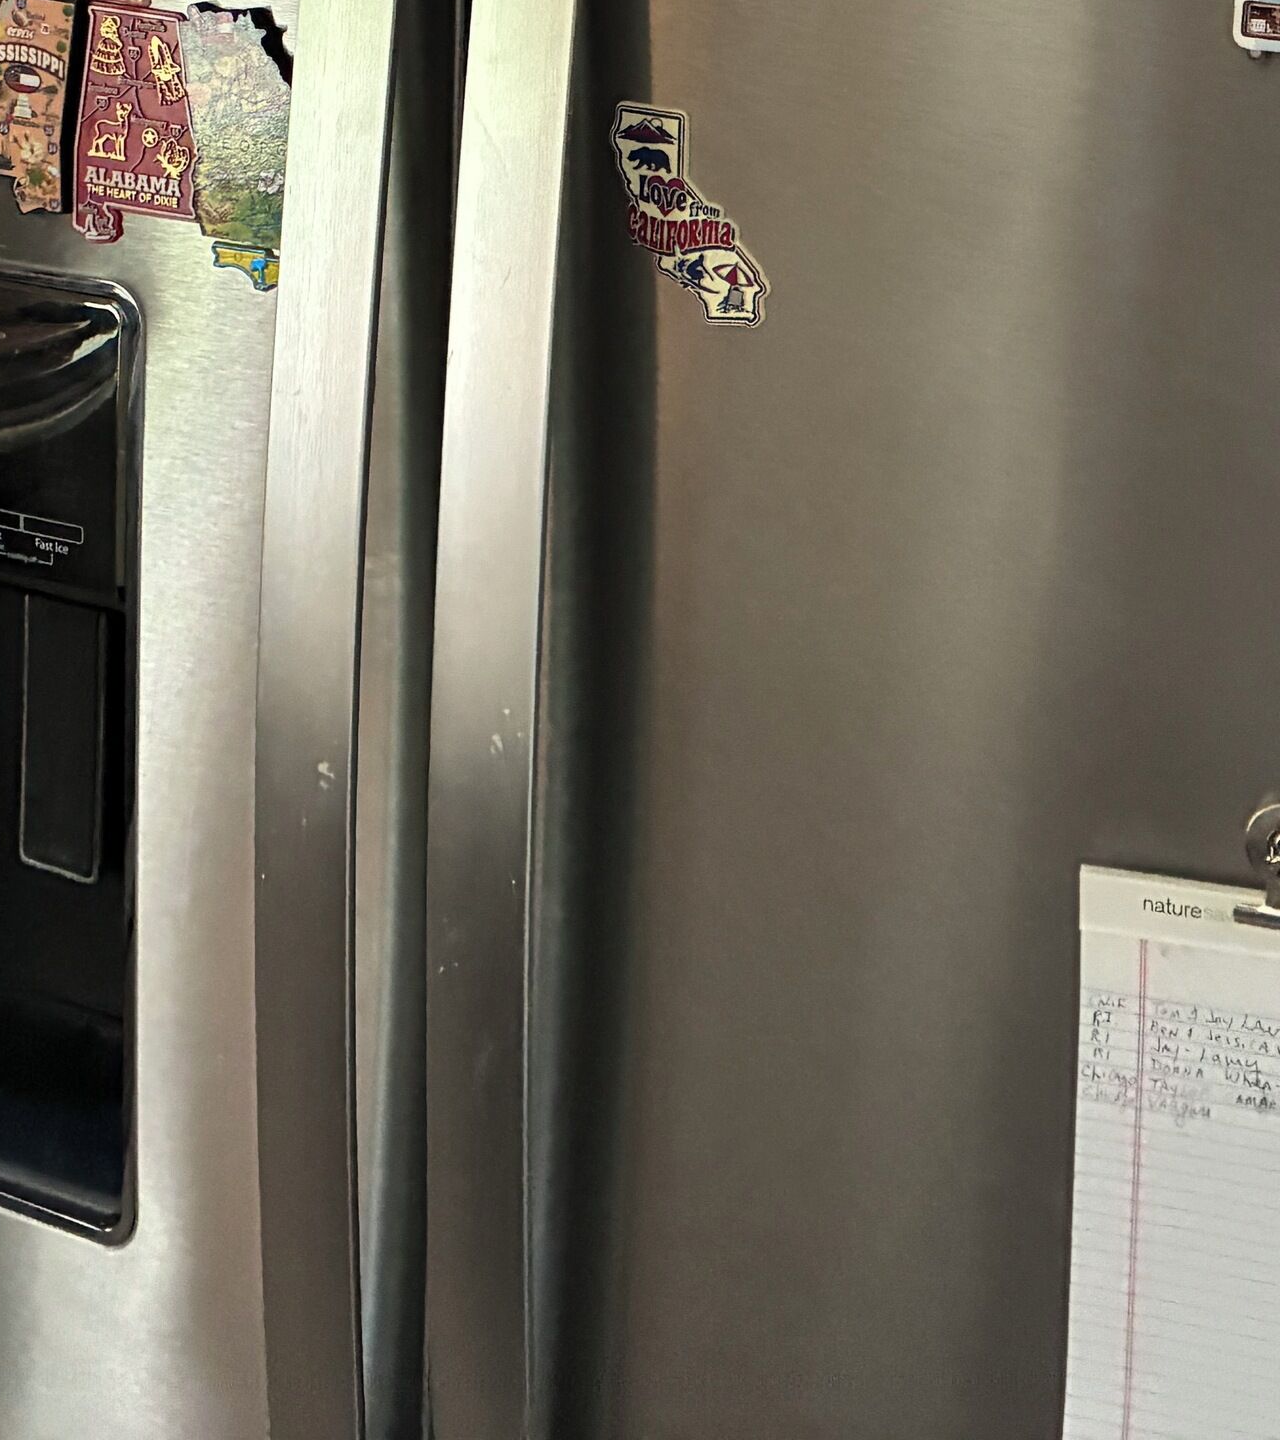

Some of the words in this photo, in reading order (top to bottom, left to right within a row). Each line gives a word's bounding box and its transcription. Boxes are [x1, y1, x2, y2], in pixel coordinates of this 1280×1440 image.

[84, 165, 182, 197] ALABAMA
[86, 182, 105, 197] THE
[106, 187, 136, 201] HEART
[139, 190, 152, 203] OF
[153, 192, 179, 209] DIXIE
[689, 200, 720, 219] from
[35, 537, 54, 553] Fast
[54, 540, 70, 556] Ice
